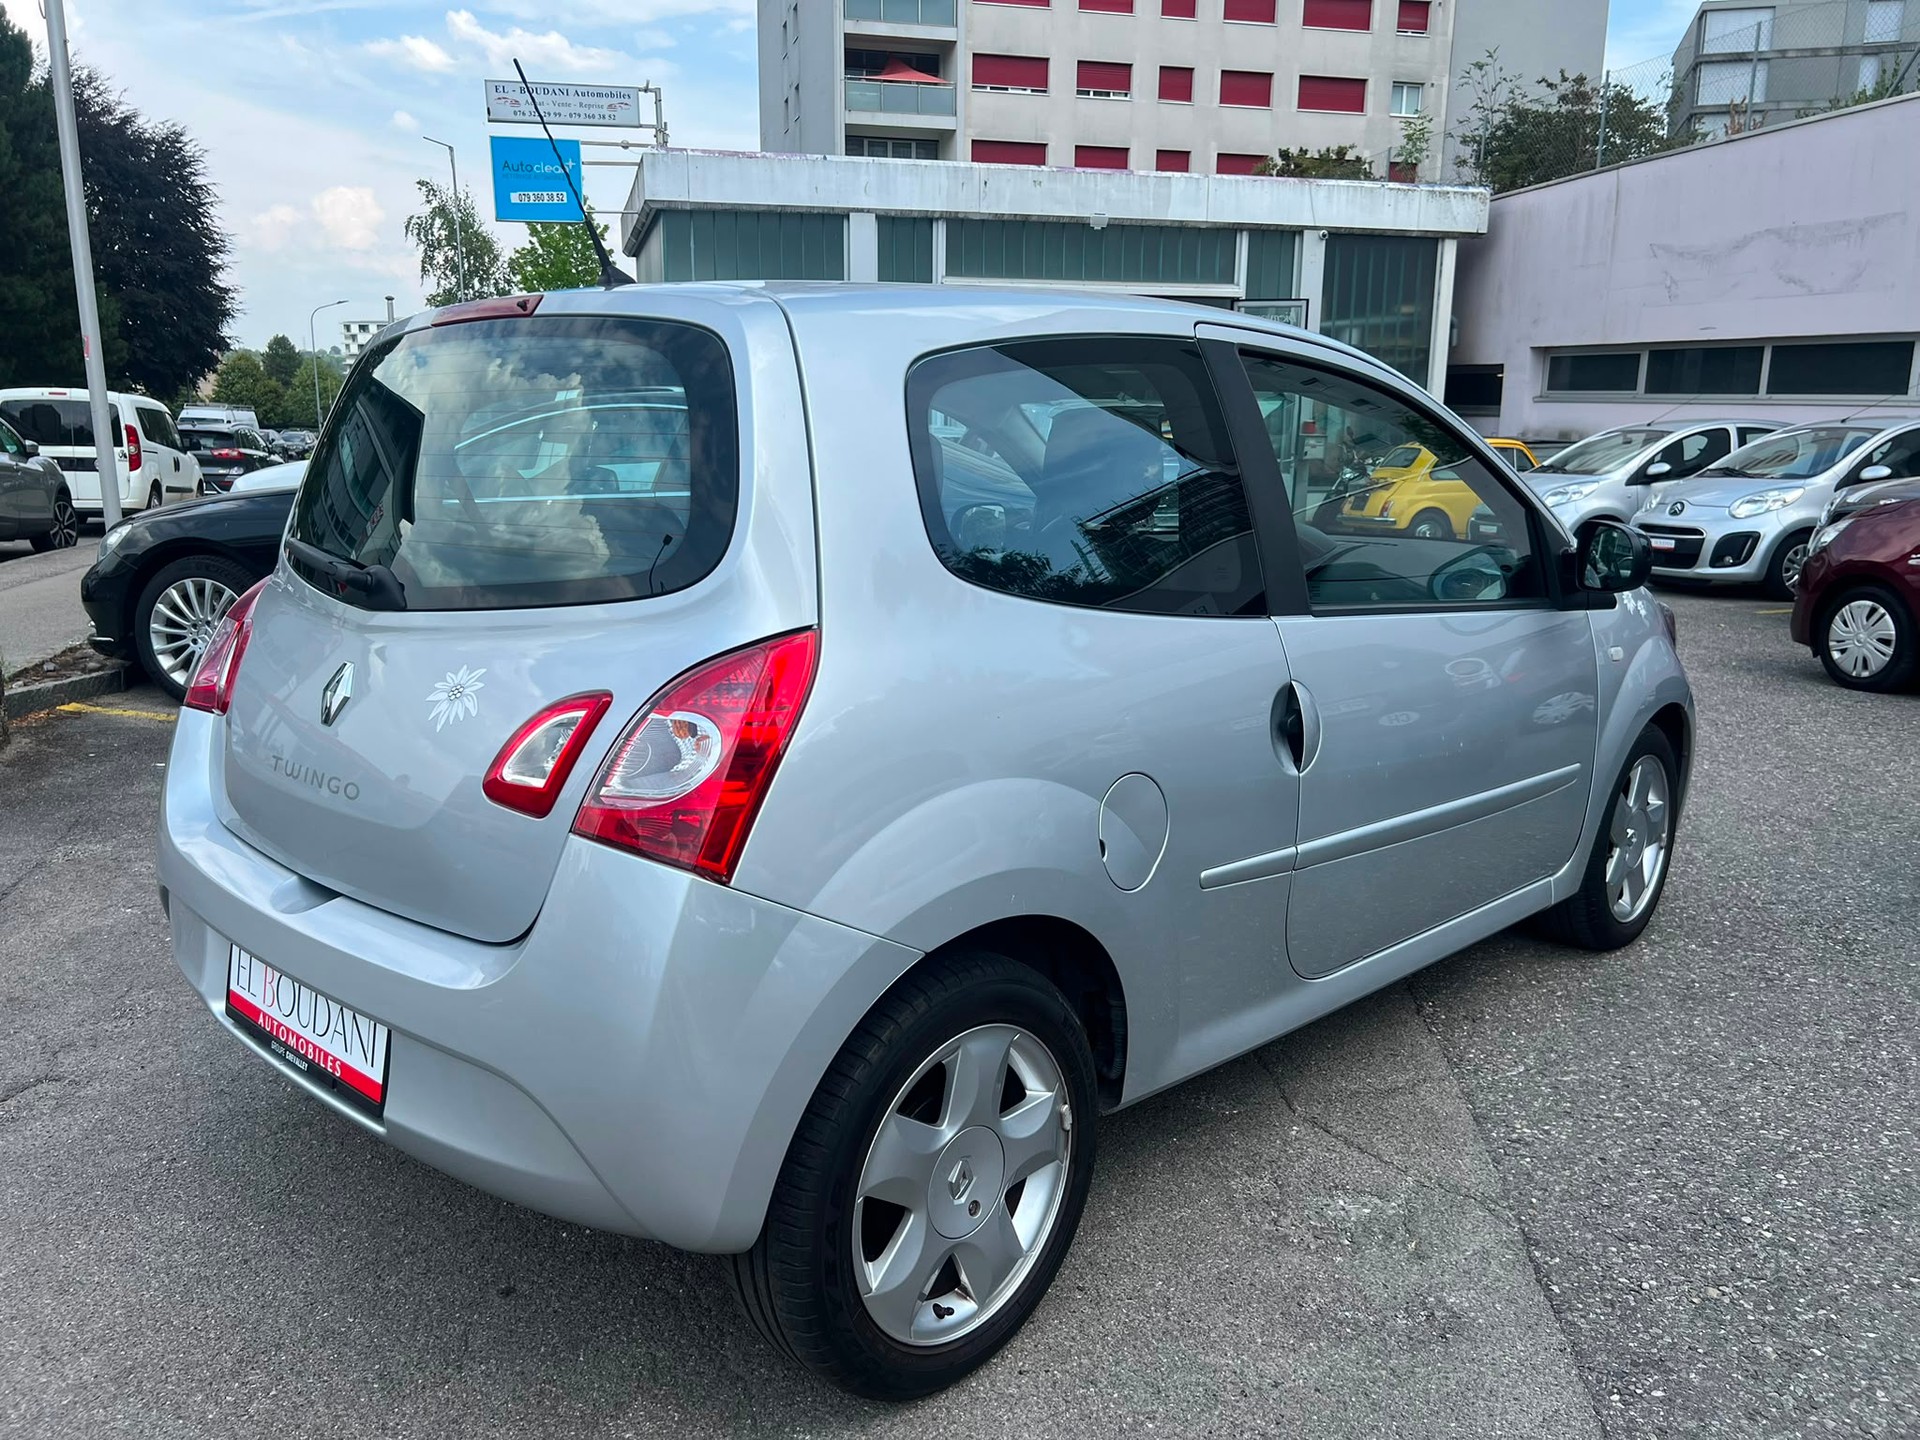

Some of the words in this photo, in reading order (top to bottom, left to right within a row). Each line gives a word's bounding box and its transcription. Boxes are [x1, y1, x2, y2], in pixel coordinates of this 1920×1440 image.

[495, 85, 509, 94] EL
[519, 86, 569, 97] BOUDANI
[573, 89, 631, 100] Automobiles
[524, 99, 545, 107] Acat
[551, 100, 572, 108] Vente
[578, 101, 604, 111] Reprise
[528, 110, 541, 118] 32
[518, 193, 531, 202] 079
[545, 193, 555, 202] 38
[556, 193, 565, 202] 52
[272, 755, 360, 801] TWINGO
[237, 948, 257, 997] EL
[263, 965, 377, 1068] BOUDANI
[258, 1012, 342, 1077] AUTOMOBILES
